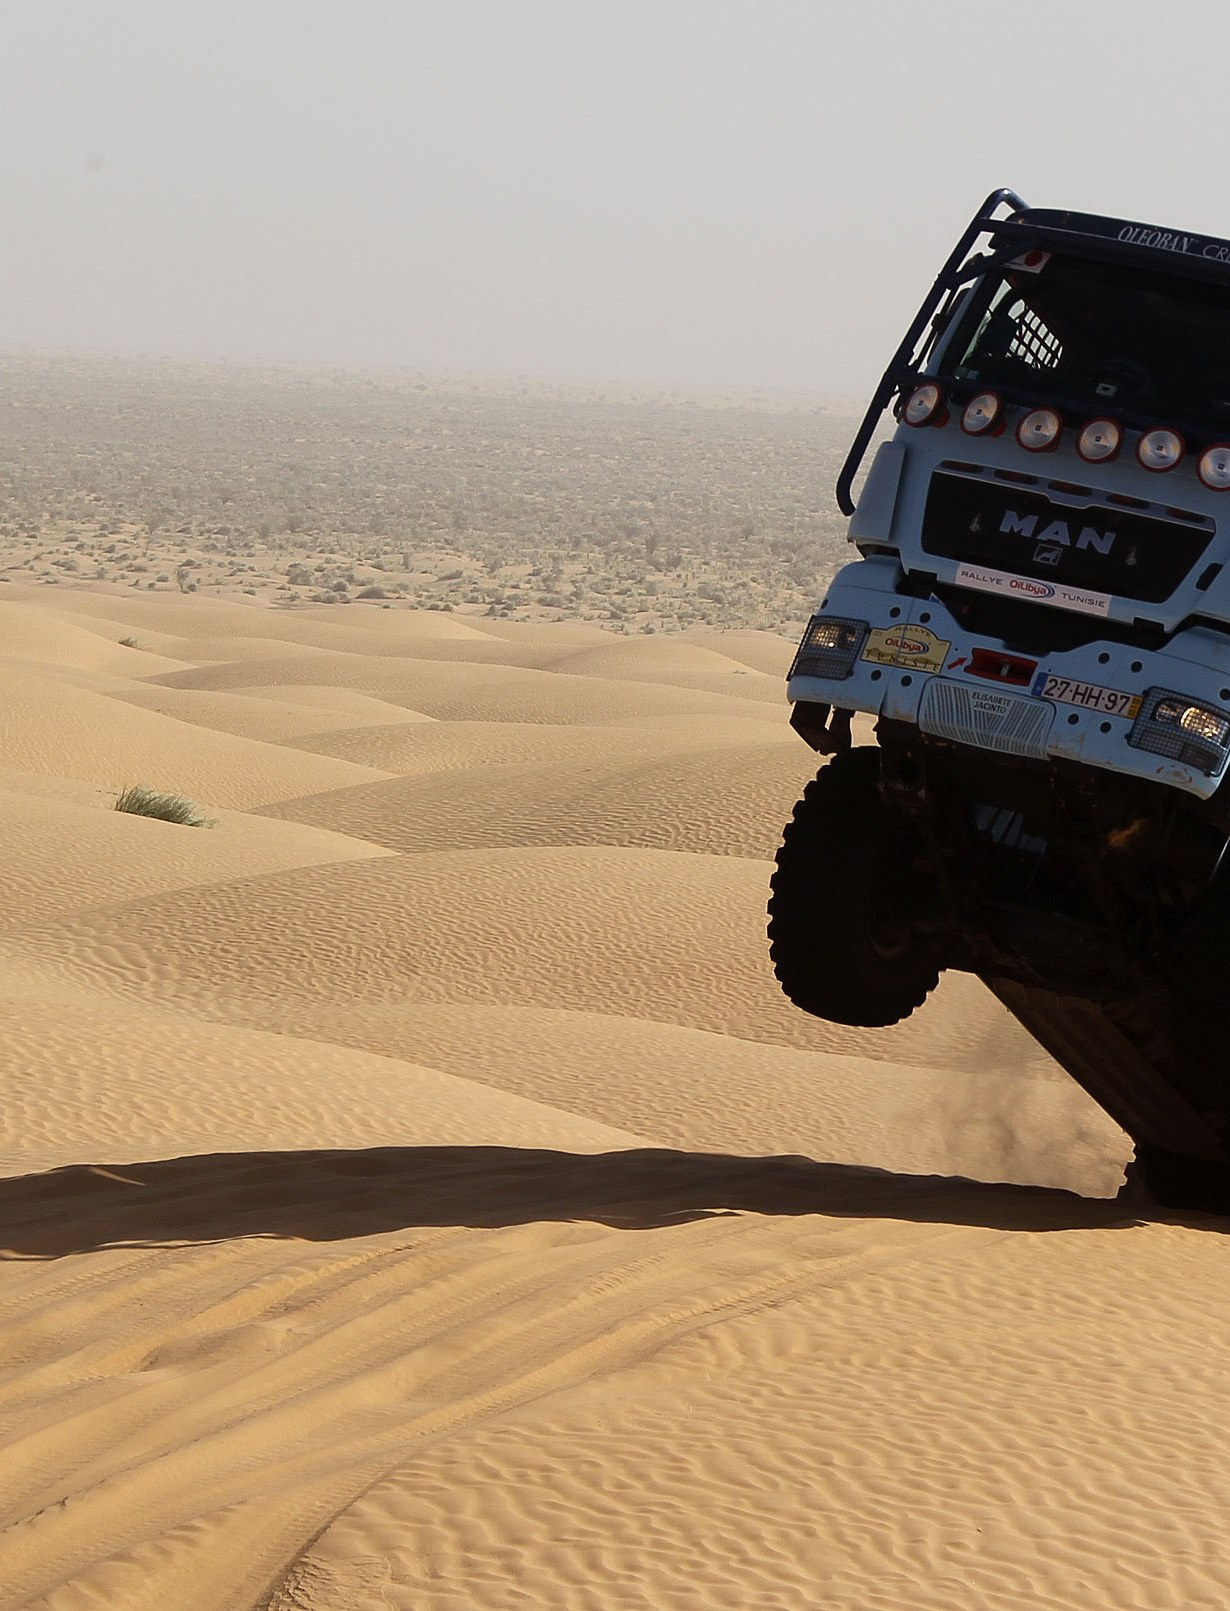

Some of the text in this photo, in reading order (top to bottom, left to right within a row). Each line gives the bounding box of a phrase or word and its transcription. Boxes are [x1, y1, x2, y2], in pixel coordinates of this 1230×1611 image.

[1117, 225, 1195, 253] OLEOBAN
[1000, 510, 1117, 555] MAN
[961, 570, 1106, 609] RALLYE OiLibya TUNISIE
[865, 649, 941, 671] TUNISIE
[972, 691, 1011, 706] ELISABETE
[972, 701, 1007, 714] JACINTO
